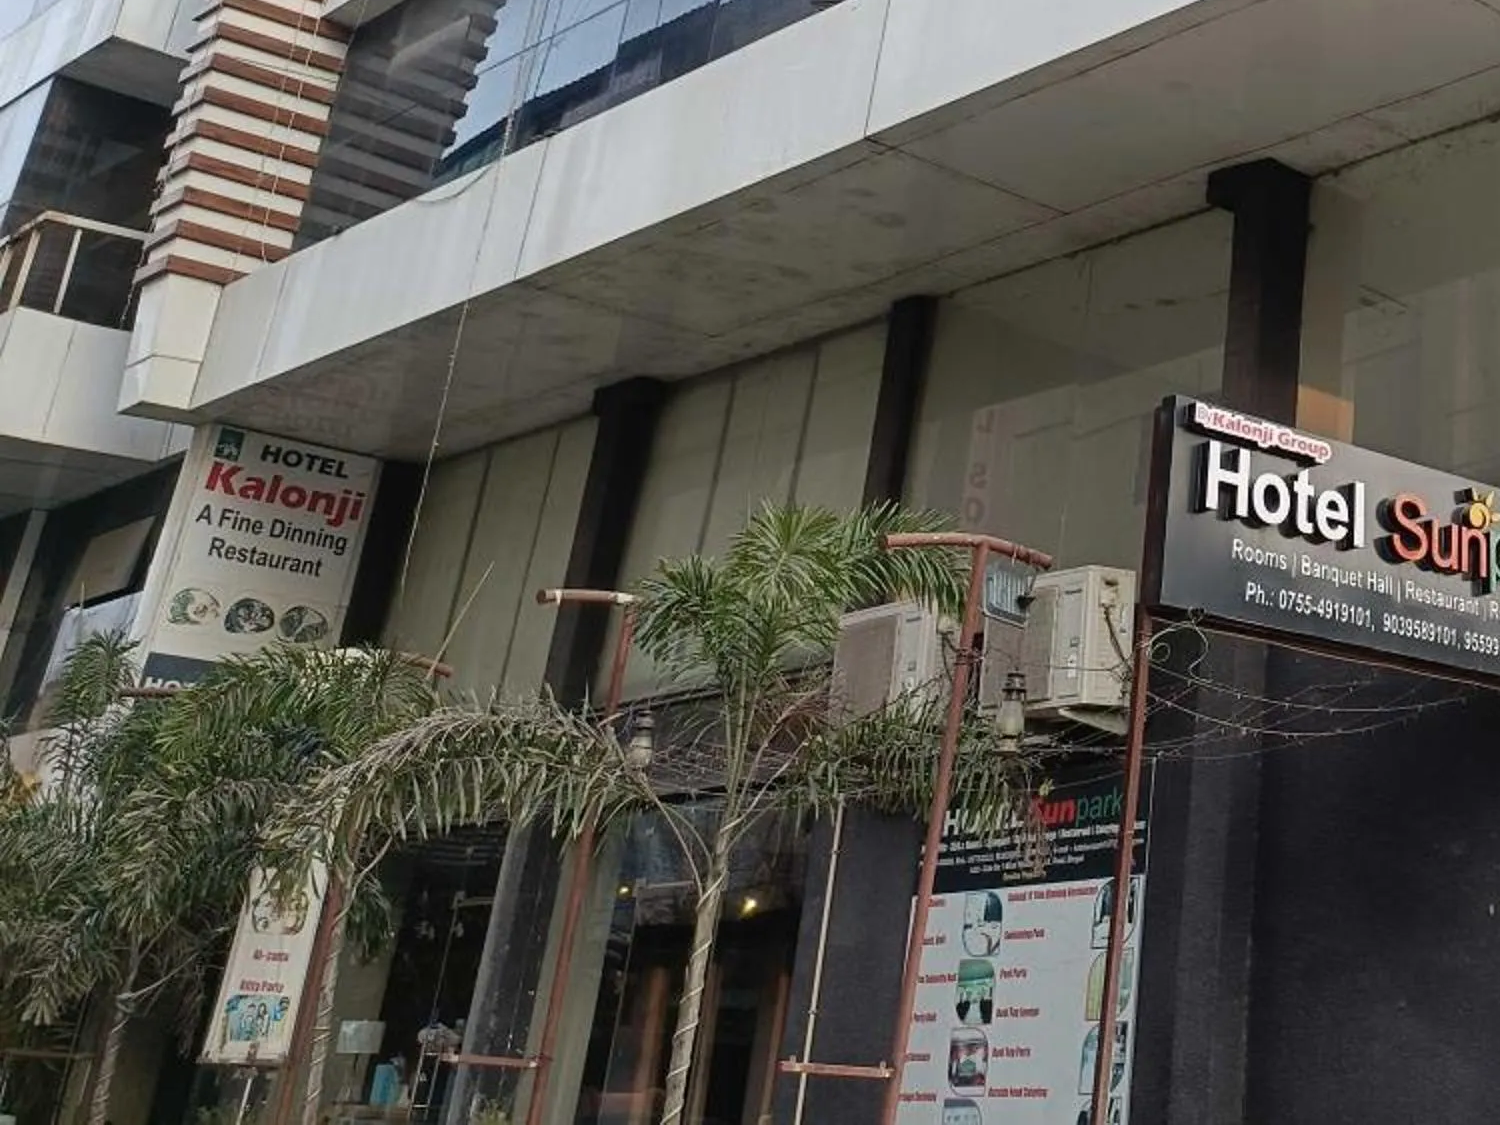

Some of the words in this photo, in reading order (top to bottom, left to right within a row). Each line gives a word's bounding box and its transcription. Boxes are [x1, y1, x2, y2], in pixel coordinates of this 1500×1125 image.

[260, 444, 348, 478] HOTEL
[1212, 411, 1273, 443] Kalonji
[1277, 431, 1330, 461] Group
[204, 460, 366, 529] Kalonji
[1204, 439, 1365, 548] Hotel
[195, 503, 212, 526] A
[217, 508, 263, 536] Fine
[268, 518, 348, 556] Dinning
[207, 536, 323, 577] Restaurant
[1231, 538, 1287, 571] Rooms
[1301, 554, 1363, 589] Banquet
[1366, 570, 1394, 597] Hall
[1405, 580, 1480, 618] Restaurant
